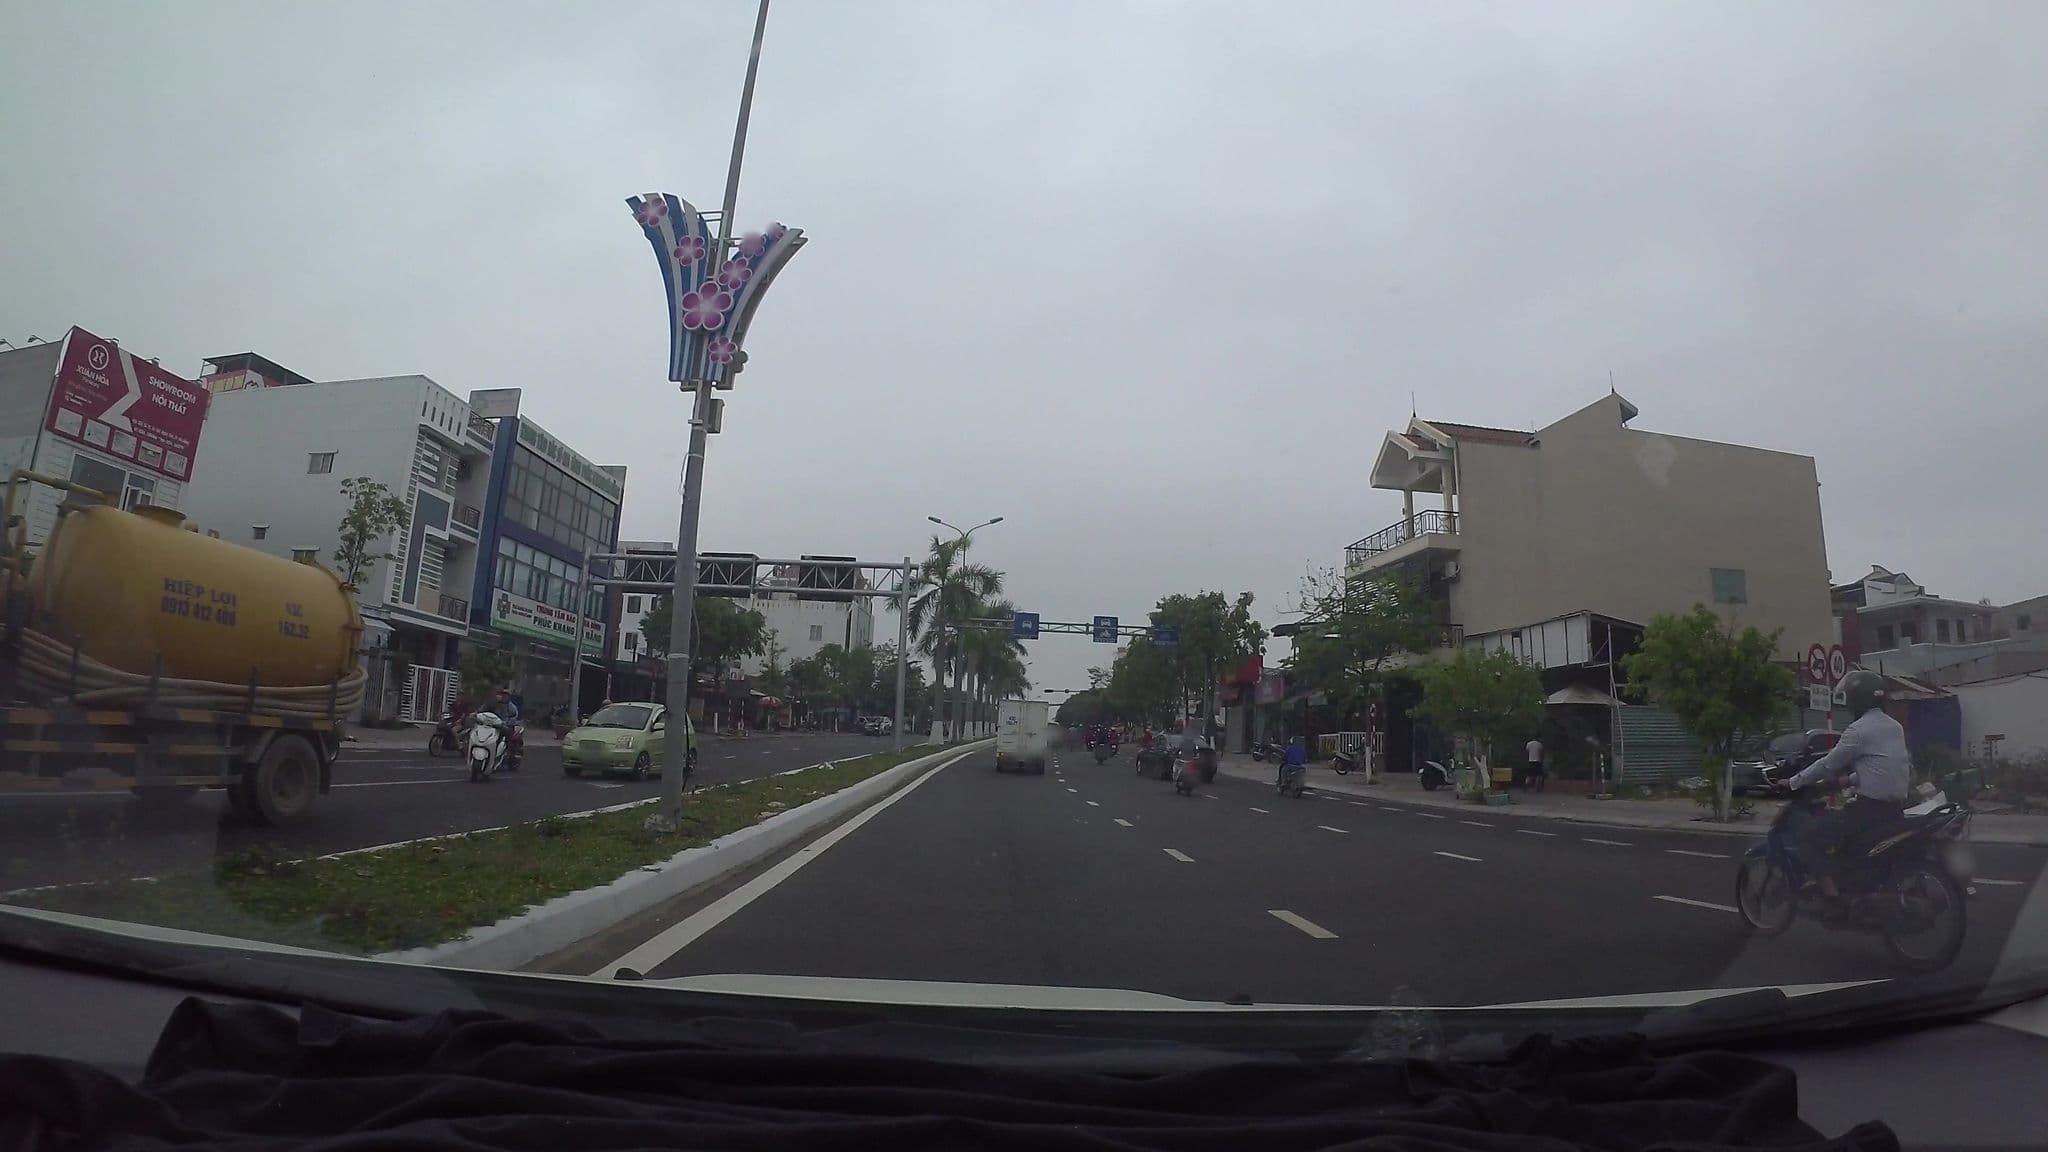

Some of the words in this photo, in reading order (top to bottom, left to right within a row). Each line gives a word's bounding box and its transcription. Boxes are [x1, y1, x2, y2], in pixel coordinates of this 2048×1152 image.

[148, 376, 197, 404] SHOWROOM
[152, 393, 168, 407] NỘI
[168, 400, 188, 415] THẤT
[533, 615, 552, 629] PHÚC
[553, 621, 575, 635] KHANG
